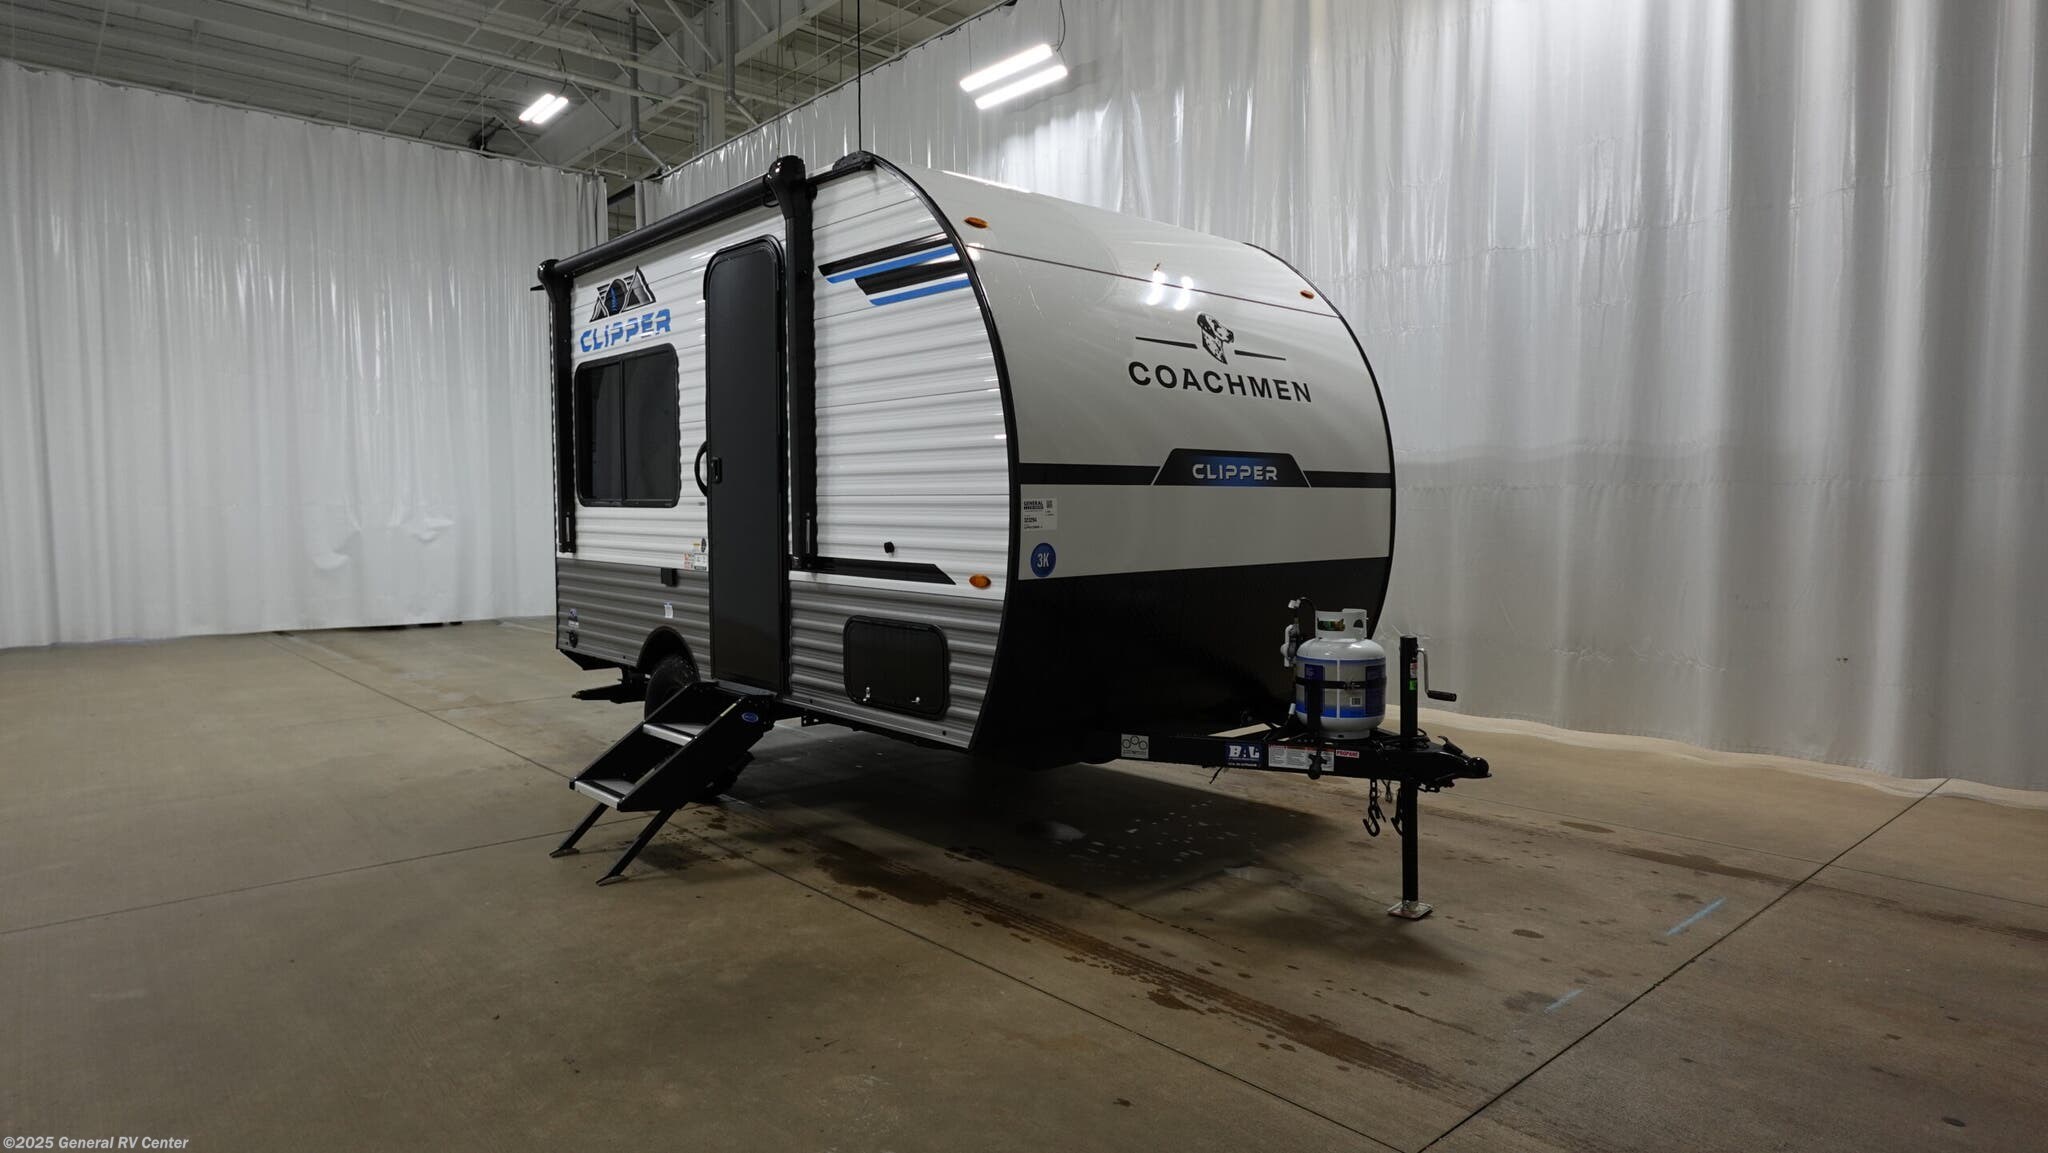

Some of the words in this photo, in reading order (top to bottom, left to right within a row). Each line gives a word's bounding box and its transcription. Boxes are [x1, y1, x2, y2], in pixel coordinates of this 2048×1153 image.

[580, 308, 671, 353] CLIPPER
[1128, 361, 1312, 403] COACHMEN
[1192, 463, 1278, 481] CLIPPER
[1037, 553, 1049, 567] 3K
[1229, 745, 1260, 758] BAL
